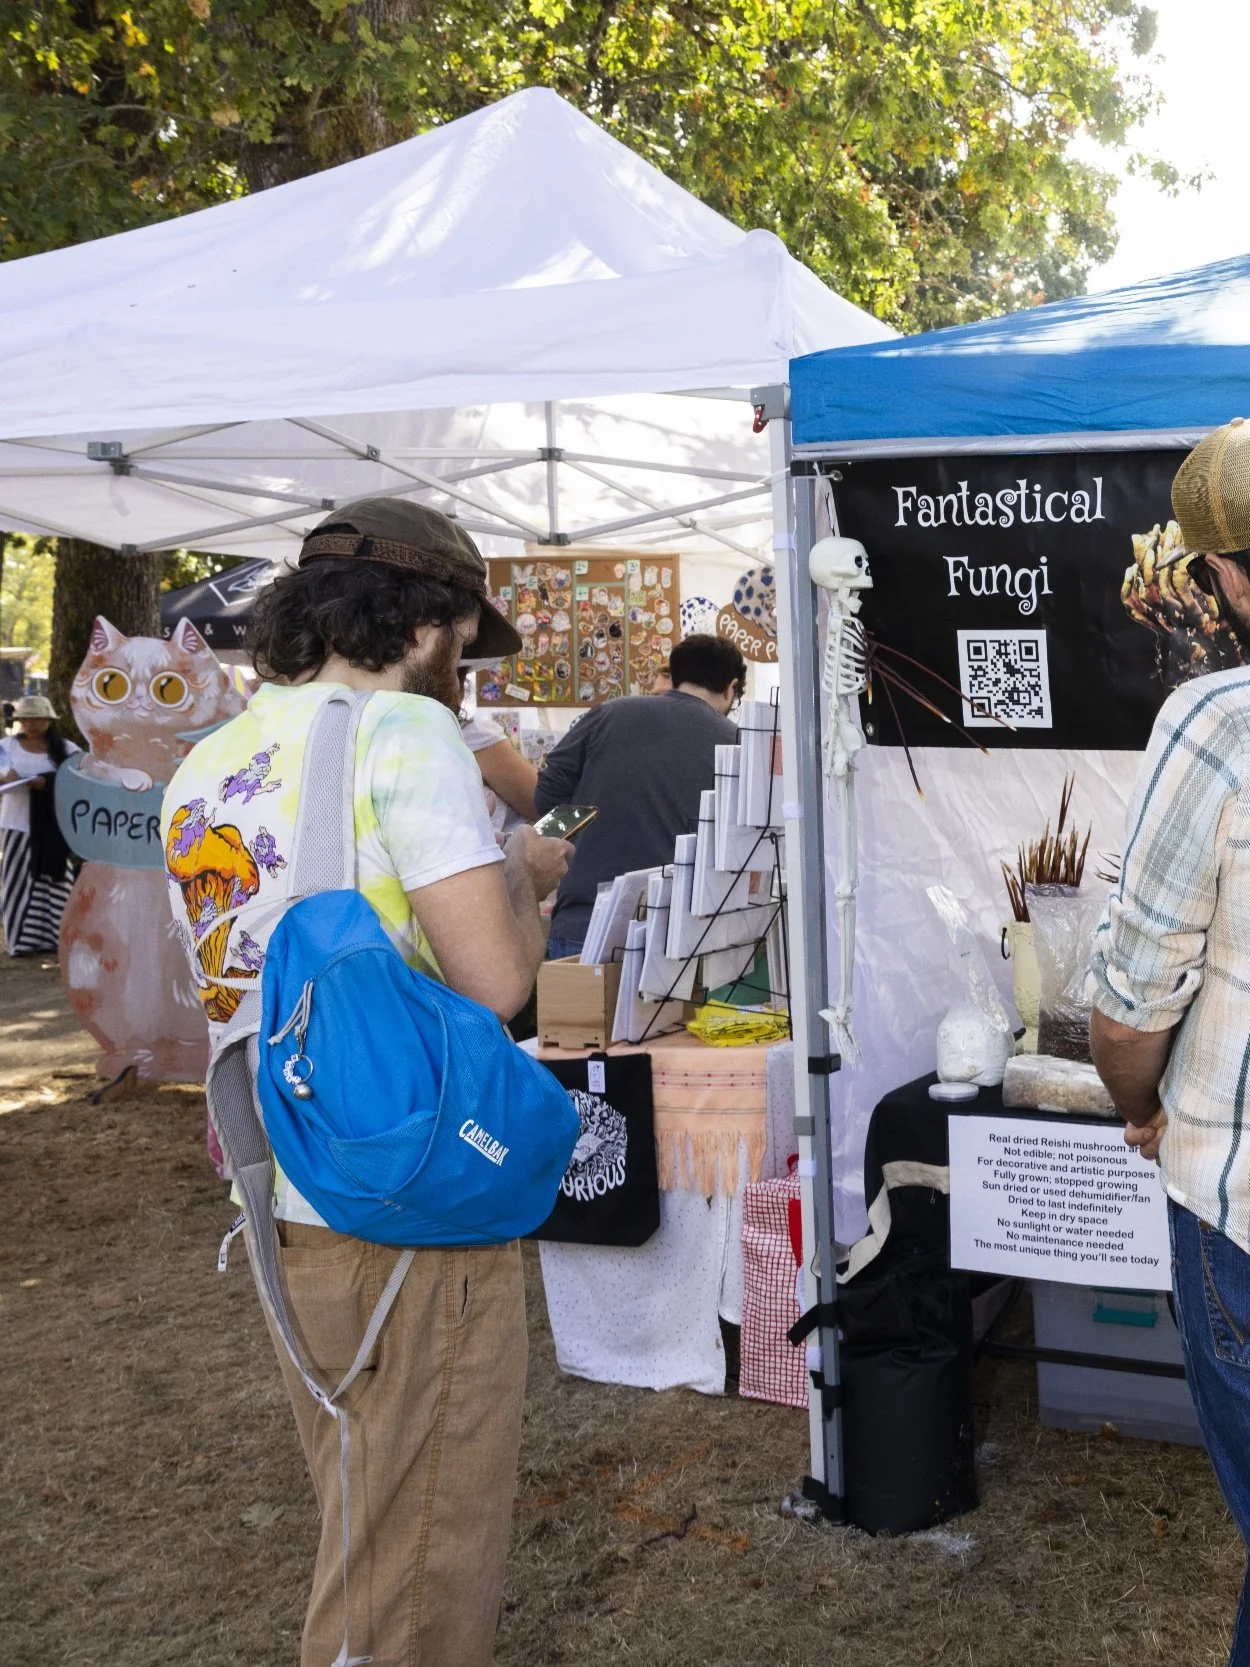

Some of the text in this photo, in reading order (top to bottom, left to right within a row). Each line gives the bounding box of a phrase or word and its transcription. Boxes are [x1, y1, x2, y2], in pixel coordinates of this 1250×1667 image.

[891, 476, 1106, 528] Fantastical
[942, 555, 1054, 616] Fungi
[719, 613, 761, 657] PAPER
[71, 799, 161, 845] PAPER
[458, 1119, 510, 1167] CAMELBAK
[989, 1133, 1139, 1153] Real dried Reishi mushroom ar
[1004, 1146, 1021, 1156] Not
[1058, 1153, 1074, 1161] not
[1076, 1154, 1127, 1165] poisonous
[558, 1155, 626, 1202] URIOUS
[977, 1156, 1155, 1179] For decorative and artistic purposes
[982, 1180, 1001, 1190] Sun
[1003, 1183, 1028, 1193] dried
[1043, 1188, 1066, 1197] used
[994, 1169, 1016, 1182] Fully
[1055, 1176, 1094, 1188] stopped
[1096, 1181, 1138, 1192] growing
[1008, 1195, 1123, 1216] Dried to last indefinitely
[1021, 1208, 1108, 1225] Keep in dry space
[997, 1218, 1011, 1227] No
[1013, 1221, 1050, 1233] sunlight
[1065, 1227, 1093, 1236] water
[1096, 1230, 1134, 1239] needed
[1006, 1230, 1124, 1251] No maintenance needed
[974, 1238, 992, 1249] The
[994, 1243, 1017, 1252] most
[1019, 1246, 1051, 1256] unique
[1053, 1248, 1078, 1261] thing
[1110, 1255, 1128, 1263] see
[1130, 1255, 1159, 1267] today
